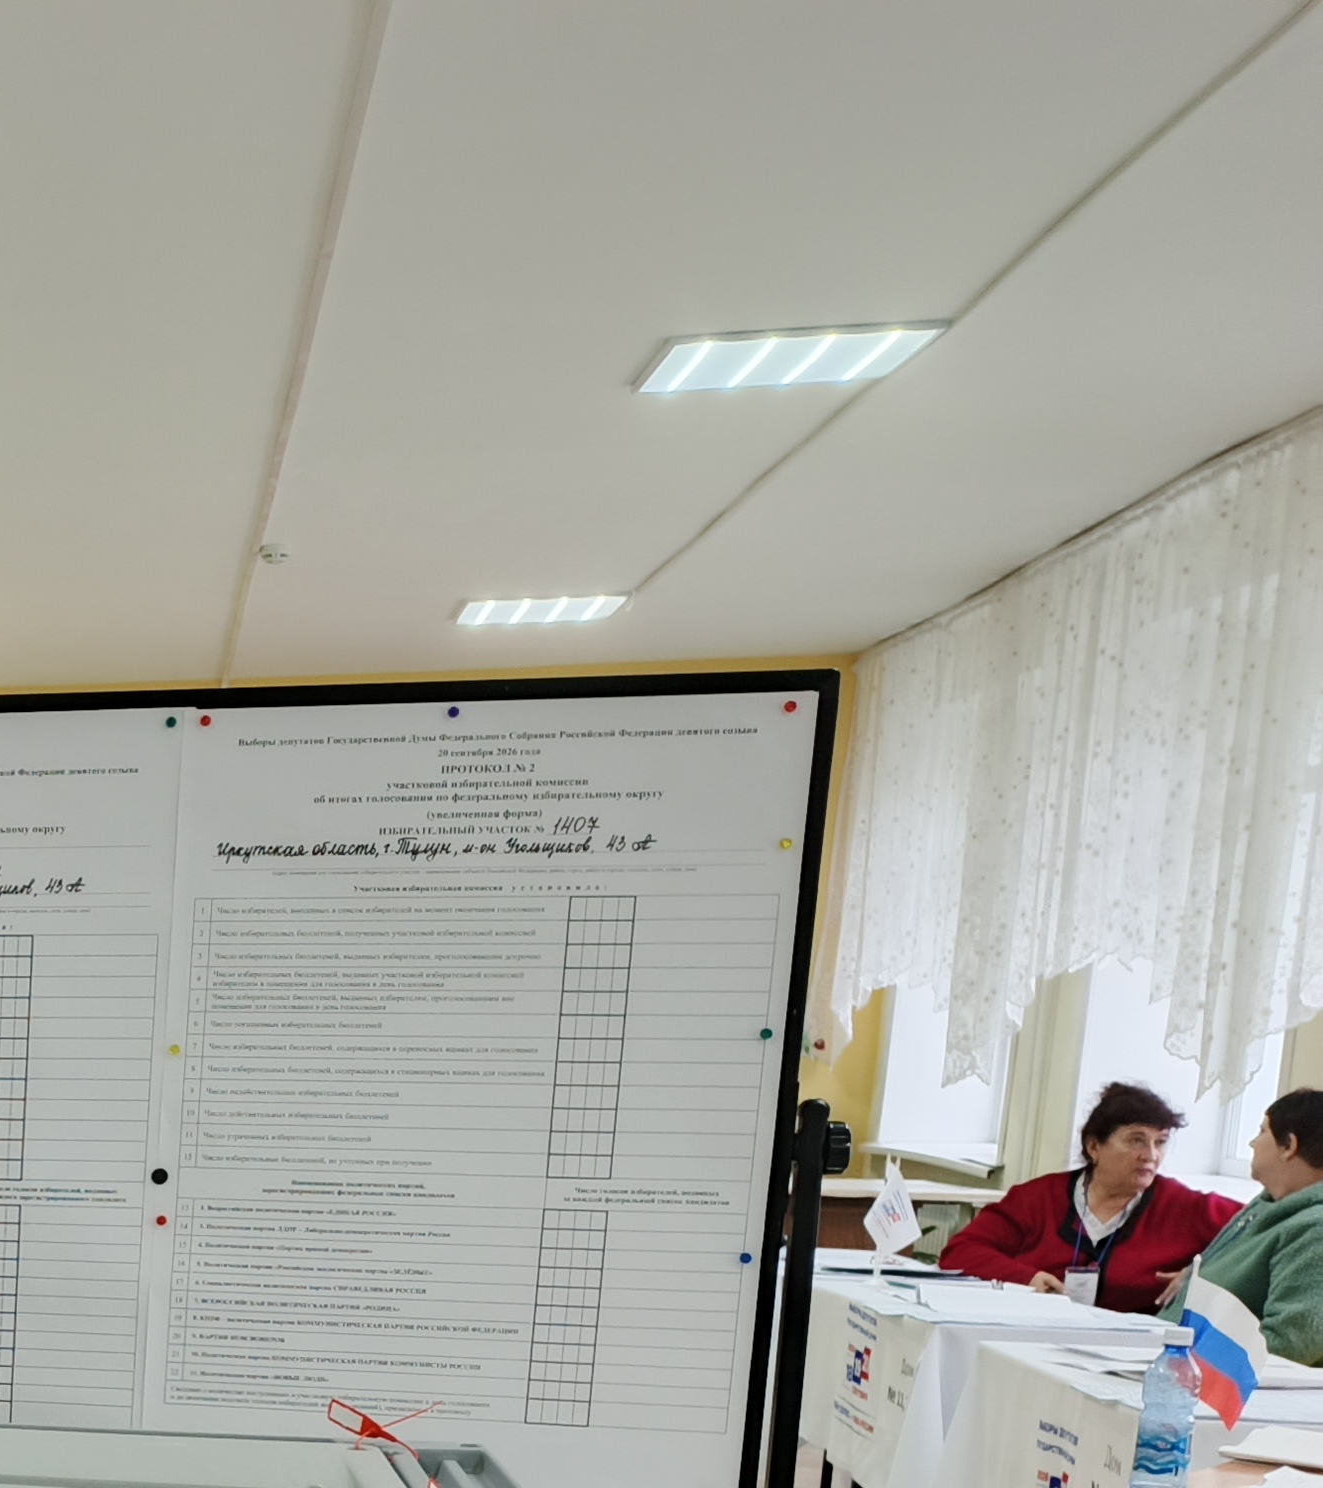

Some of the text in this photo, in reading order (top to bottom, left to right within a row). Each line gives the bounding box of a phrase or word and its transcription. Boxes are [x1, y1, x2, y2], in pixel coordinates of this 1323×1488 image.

[238, 738, 276, 747] Выборы
[441, 764, 510, 774] ПРОТОКОЛ
[529, 763, 535, 773] 2
[552, 815, 600, 836] 1407
[379, 826, 475, 836] ИЗБИРАТЕЛЬНЫЙ
[478, 826, 532, 835] УЧАСТОК
